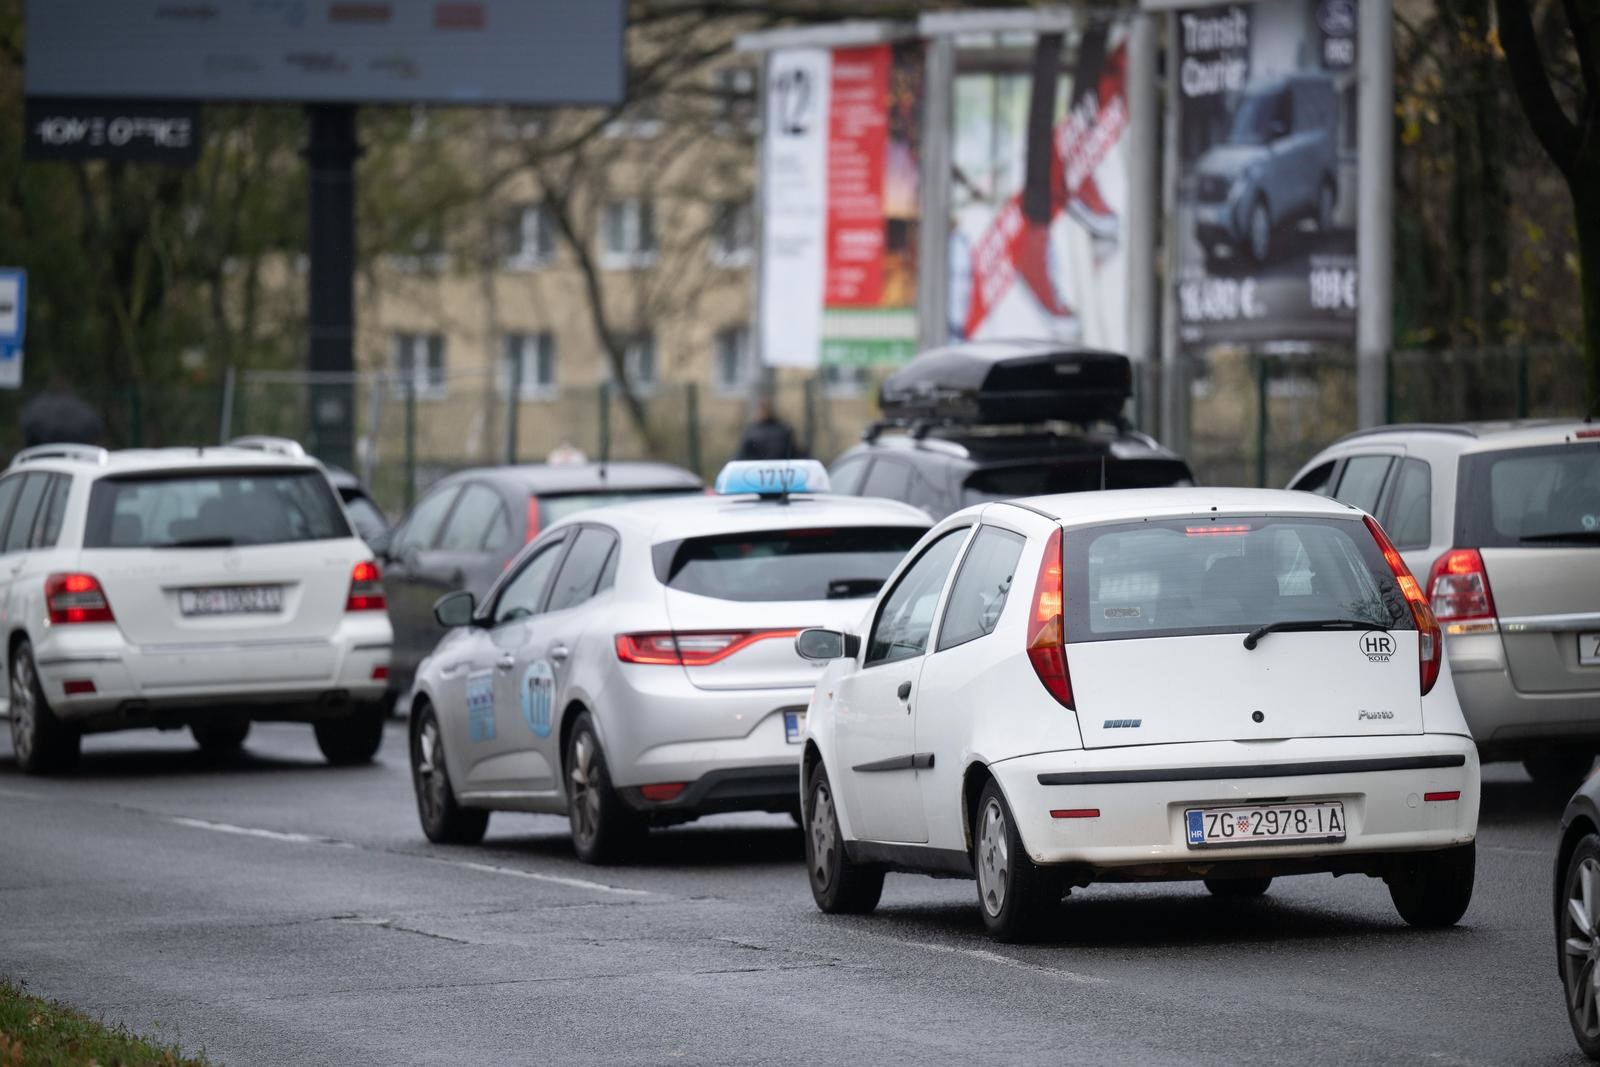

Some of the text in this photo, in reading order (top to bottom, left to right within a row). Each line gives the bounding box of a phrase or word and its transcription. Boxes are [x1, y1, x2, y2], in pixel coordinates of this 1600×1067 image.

[1182, 8, 1248, 51] Transit
[1181, 54, 1247, 97] Courier
[757, 467, 797, 487] 1717
[1366, 637, 1392, 652] HR
[1358, 709, 1394, 720] Punto
[1191, 831, 1203, 839] HR
[1205, 812, 1235, 838] ZG
